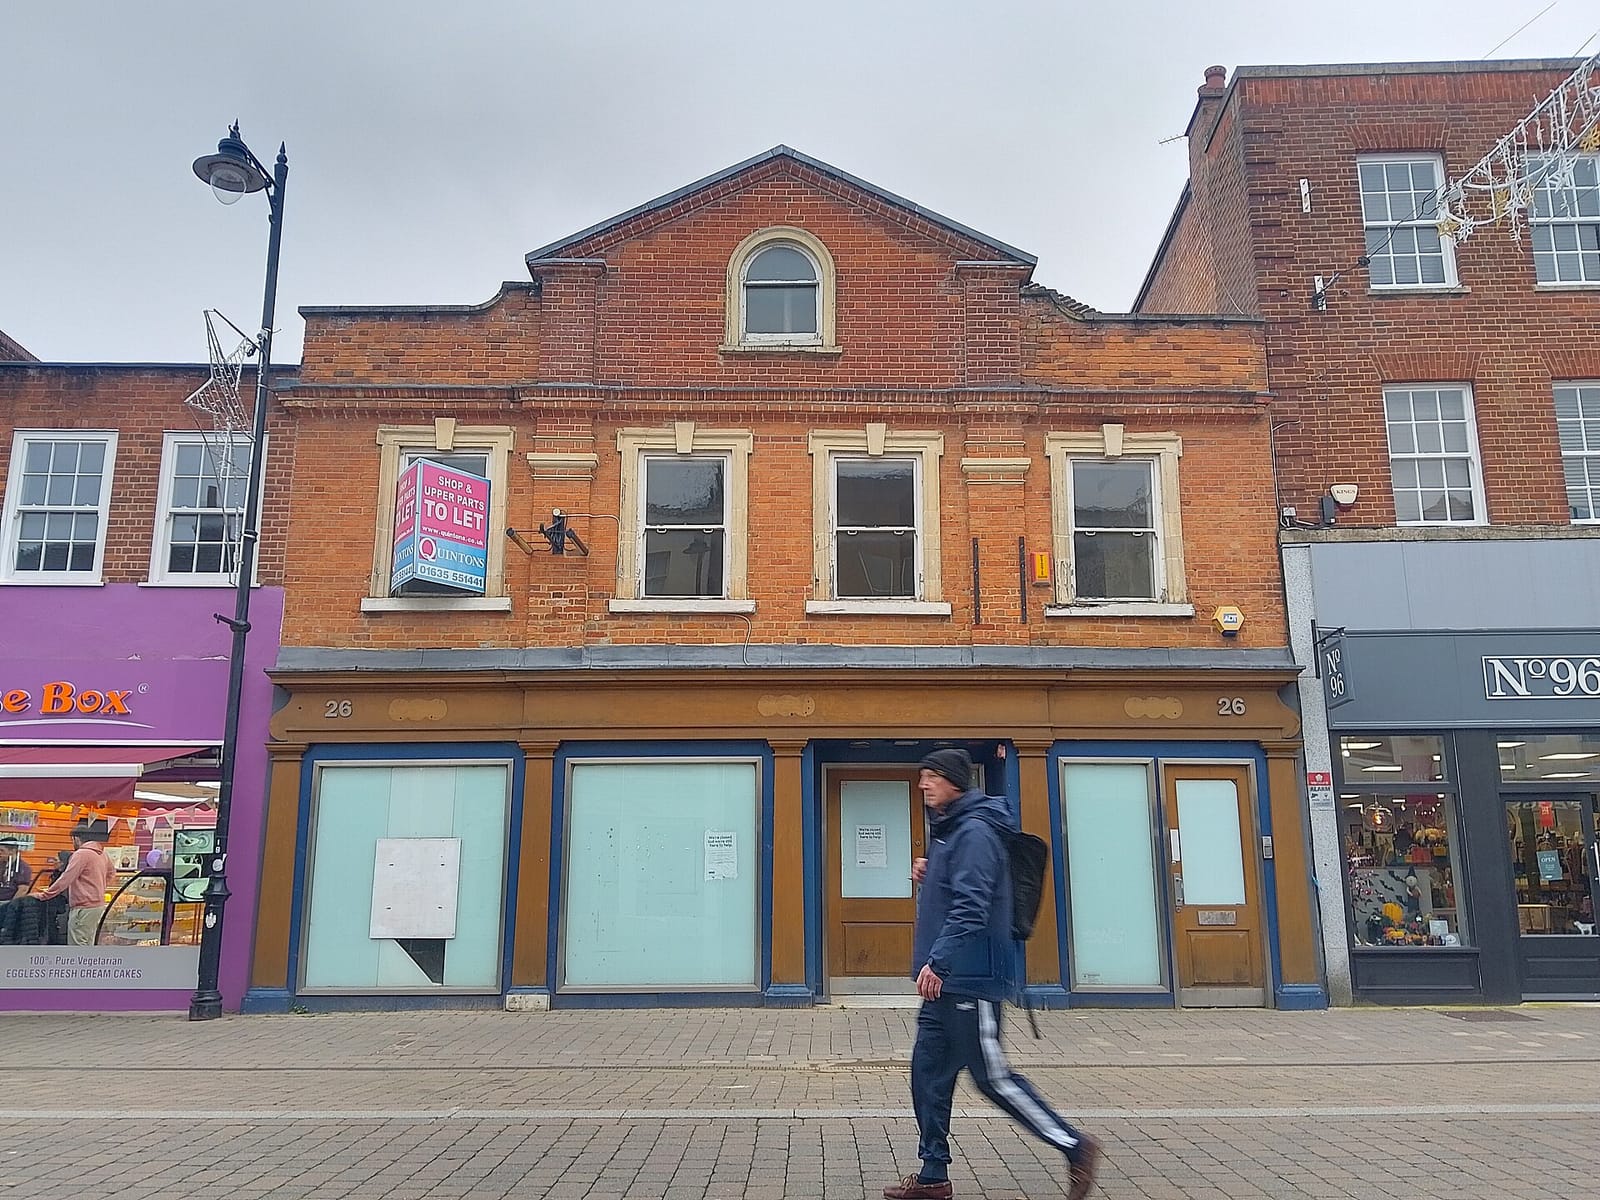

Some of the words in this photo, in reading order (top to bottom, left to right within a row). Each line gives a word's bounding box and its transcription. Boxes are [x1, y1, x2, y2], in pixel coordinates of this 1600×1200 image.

[438, 475, 464, 491] SHOP
[465, 484, 473, 494] &
[424, 485, 455, 503] UPPER
[456, 494, 485, 511] PARTS
[401, 500, 415, 524] LET
[423, 499, 448, 521] TO
[453, 506, 484, 530] LET
[422, 526, 484, 546] www.quintons.co.uk
[419, 537, 485, 568] QUINTONS
[419, 565, 449, 579] 01635
[451, 572, 483, 587] 551441
[1330, 672, 1344, 698] 96
[40, 681, 132, 714] Box
[324, 699, 352, 718] 26
[1217, 697, 1246, 716] 26
[55, 957, 75, 965] Pure
[78, 956, 122, 967] Vegetarian
[6, 969, 46, 978] EGGLESS
[48, 969, 77, 978] FRESH
[80, 969, 111, 978] CREAM
[113, 969, 142, 979] CAKES
